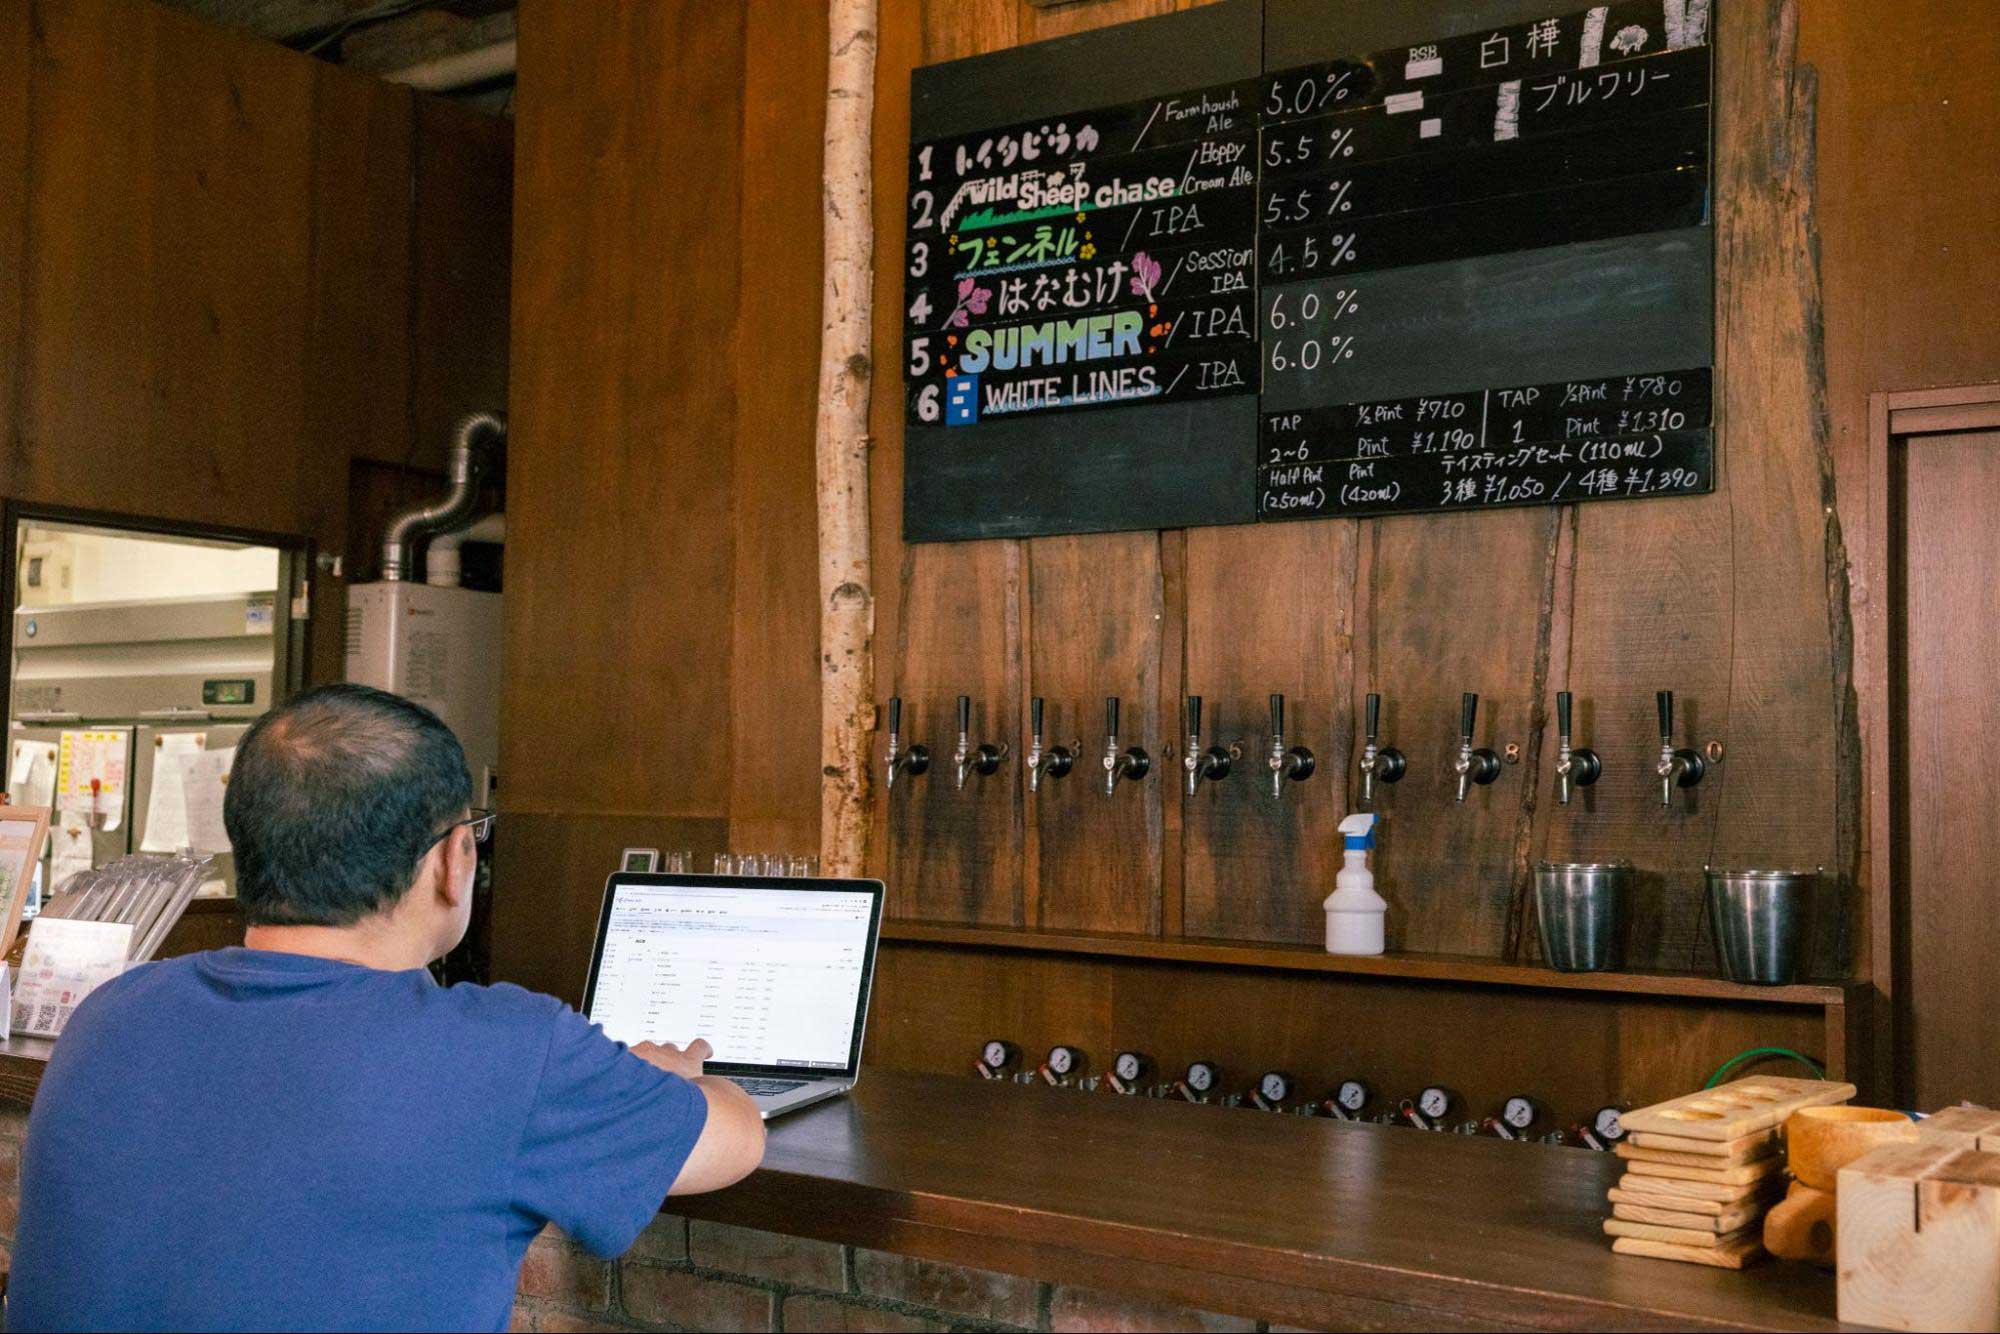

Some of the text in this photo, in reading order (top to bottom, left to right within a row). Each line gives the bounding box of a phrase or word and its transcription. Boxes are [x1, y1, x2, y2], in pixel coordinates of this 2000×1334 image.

[1409, 45, 1438, 62] BSB
[1480, 18, 1561, 69] 白樺
[1532, 69, 1670, 112] ブルワリー
[1206, 114, 1233, 134] Ale
[918, 146, 934, 181] 1
[1200, 141, 1246, 166] Hoppy
[912, 191, 935, 230] 2
[966, 174, 1019, 205] Wild
[1017, 181, 1090, 212] Sheep
[1095, 177, 1176, 208] chase
[1185, 175, 1225, 195] Cream
[1229, 166, 1254, 187] Ale
[910, 243, 930, 277] 3
[957, 225, 1079, 271] フェンネル
[1149, 204, 1205, 236] IPA
[909, 293, 932, 325] 4
[999, 261, 1129, 316] はなむけ
[1186, 248, 1254, 273] Session
[1210, 271, 1249, 294] IPA
[910, 338, 930, 376] 5
[959, 310, 1143, 374] SUMMER
[1189, 305, 1251, 338] IPA
[917, 384, 940, 422] 6
[985, 377, 1061, 411] WHITE
[1072, 365, 1157, 403] LINES
[1196, 359, 1246, 390] IPA
[1499, 387, 1541, 408] TAP
[1623, 376, 1682, 401] ¥780
[1270, 414, 1302, 432] TAP
[1416, 398, 1465, 422] ¥710
[1512, 419, 1526, 444] 1
[1566, 417, 1601, 439] Pint
[1358, 436, 1390, 458] Pint
[1270, 462, 1375, 486] Half Pint Pint
[1440, 478, 1478, 505] 3種
[1578, 469, 1619, 495] 4種
[1505, 743, 1521, 764] 8
